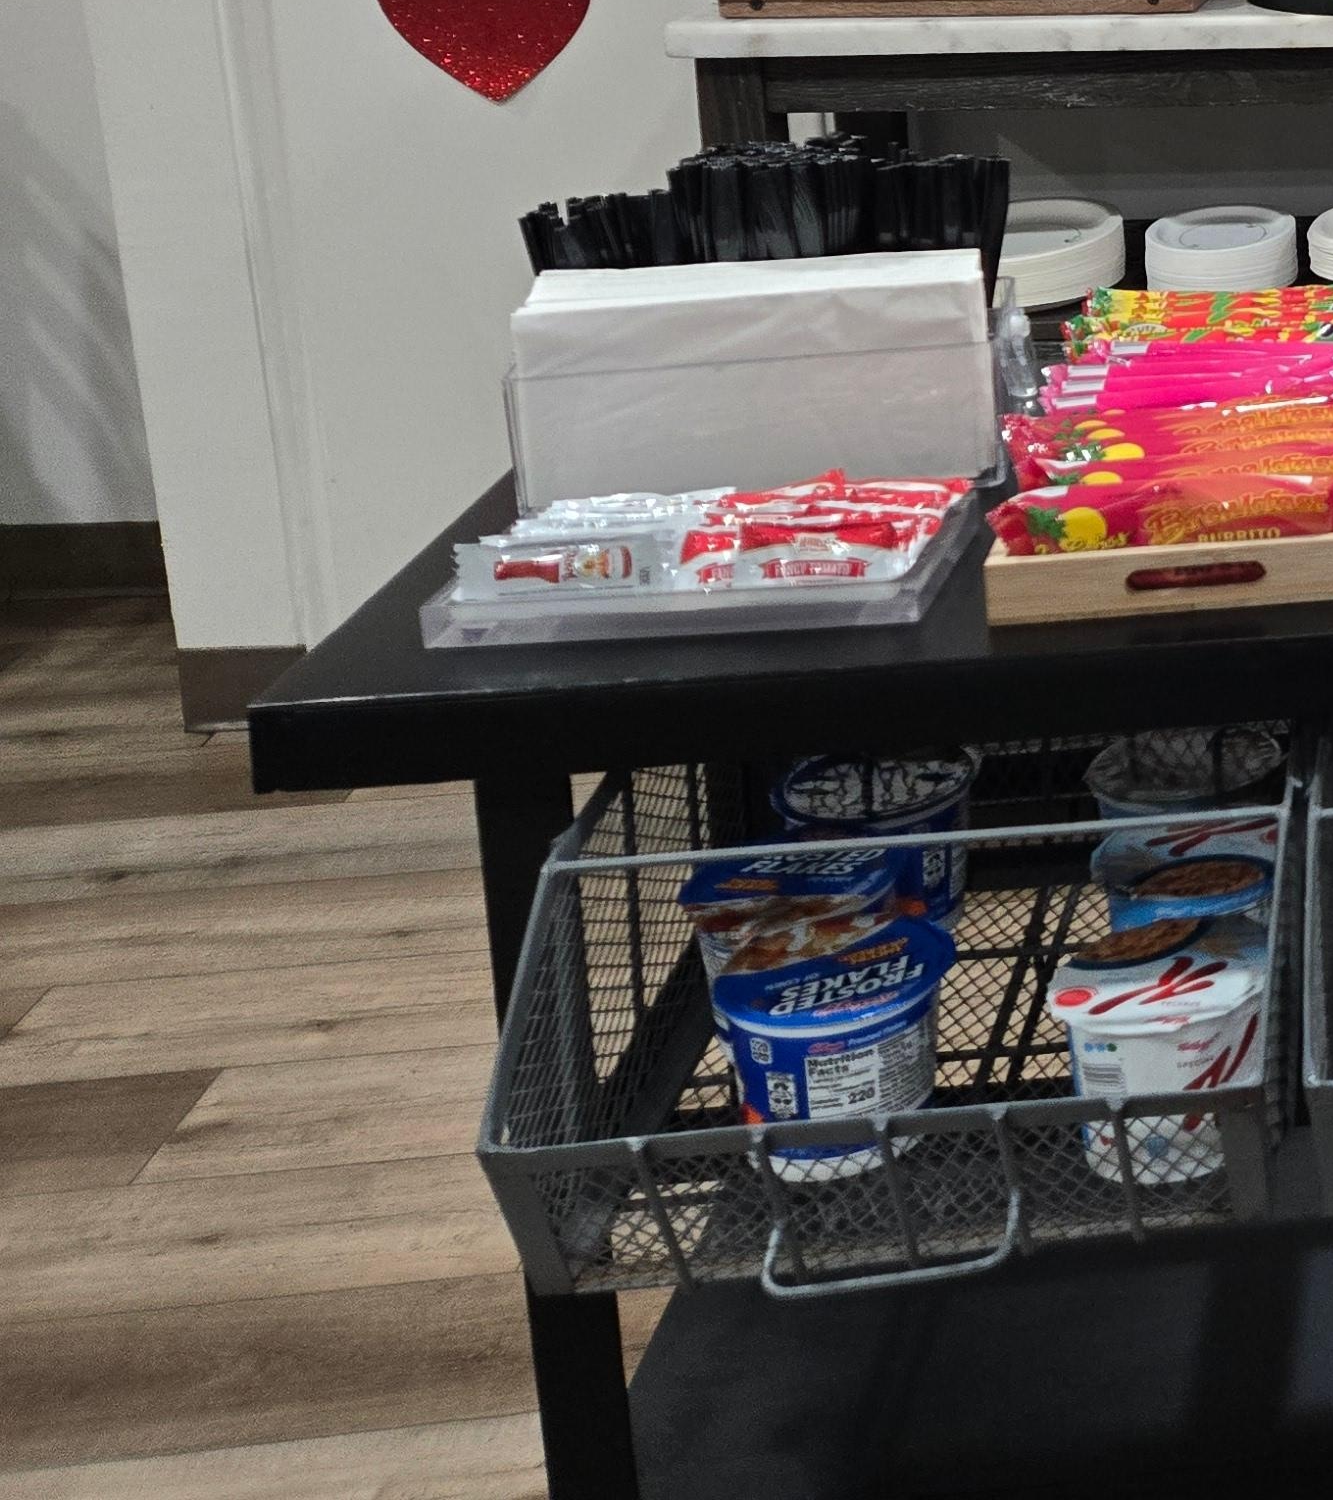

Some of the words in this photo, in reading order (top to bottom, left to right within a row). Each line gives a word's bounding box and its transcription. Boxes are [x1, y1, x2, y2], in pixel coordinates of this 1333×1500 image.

[1143, 493, 1330, 545] Breakfast
[768, 962, 925, 1017] FROSTED
[781, 954, 910, 999] FLAKES
[807, 1048, 874, 1068] Nutrition
[807, 1064, 850, 1077] Facts
[847, 1087, 876, 1105] 220
